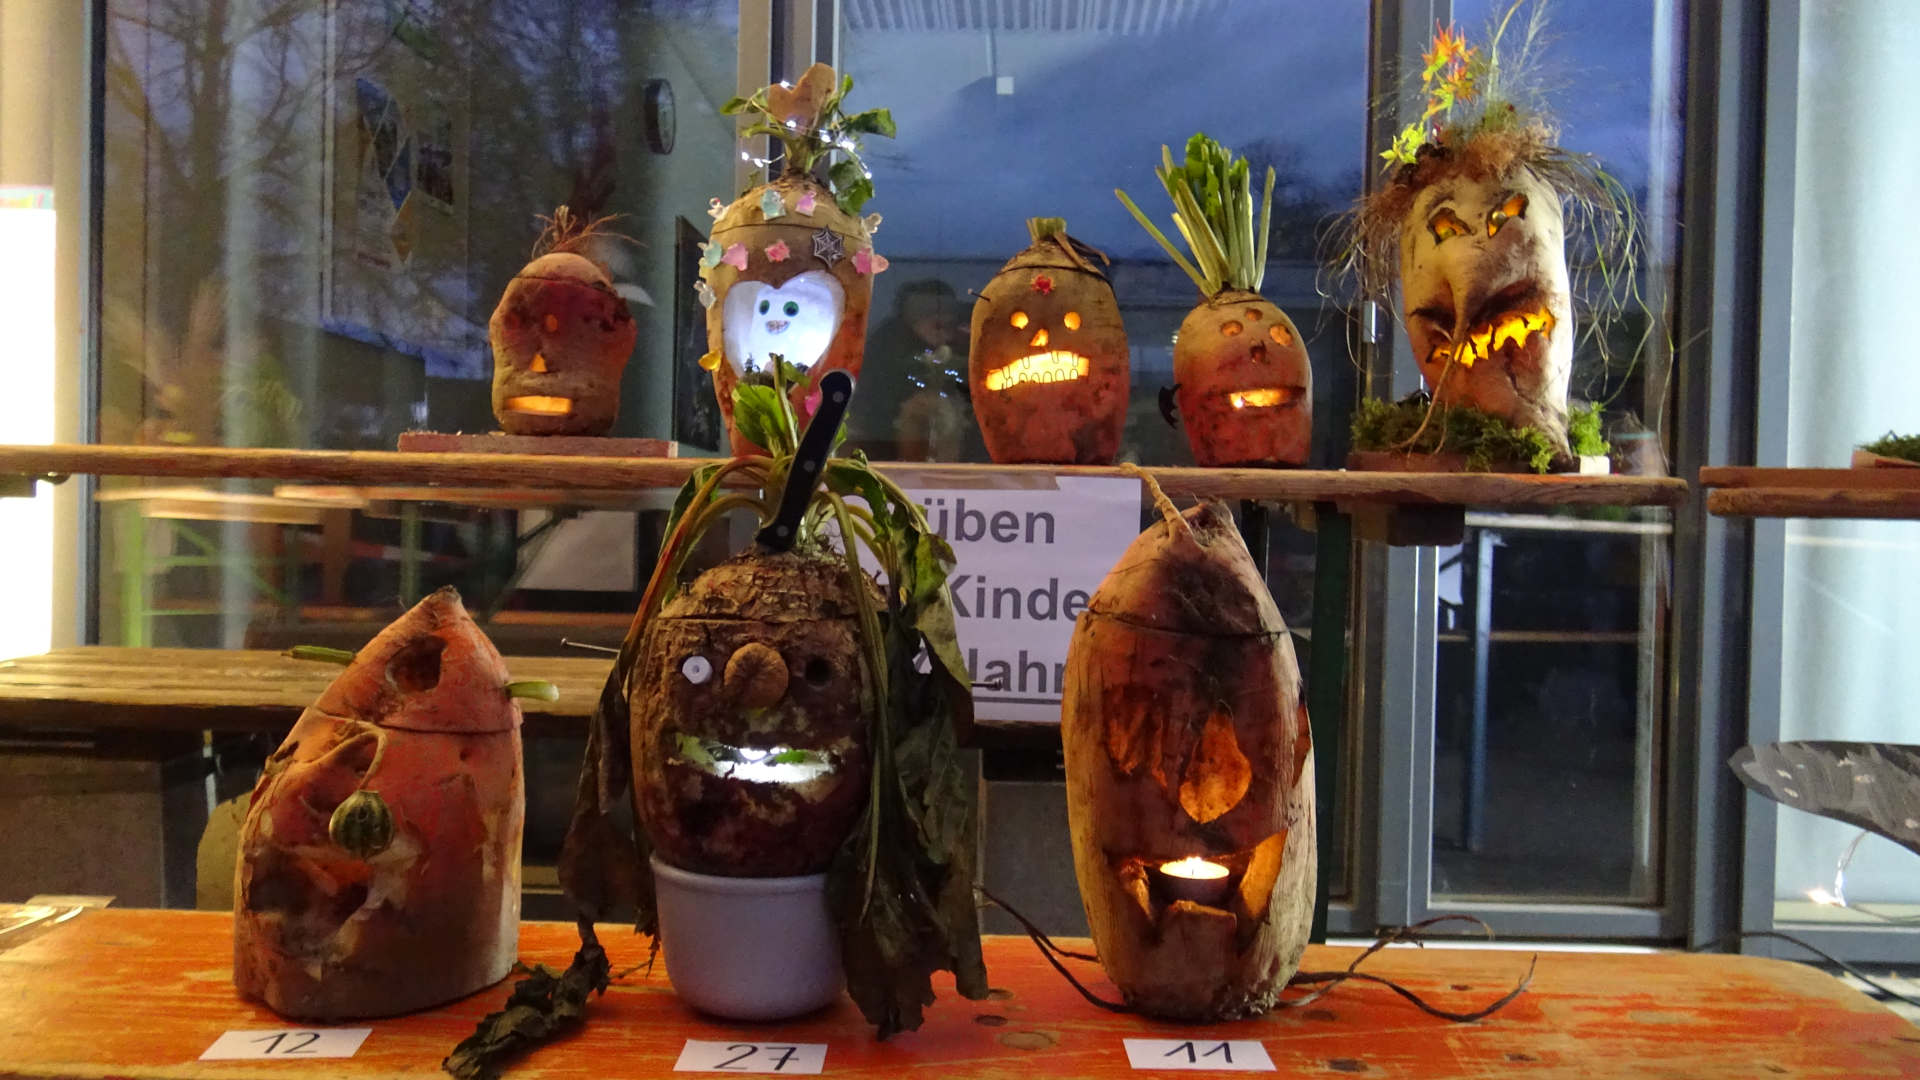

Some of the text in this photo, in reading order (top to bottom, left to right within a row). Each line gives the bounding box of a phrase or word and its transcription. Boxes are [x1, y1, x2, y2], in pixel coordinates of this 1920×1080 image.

[251, 1032, 321, 1054] 12
[1164, 1041, 1233, 1064] 11
[713, 1044, 800, 1071] 27
